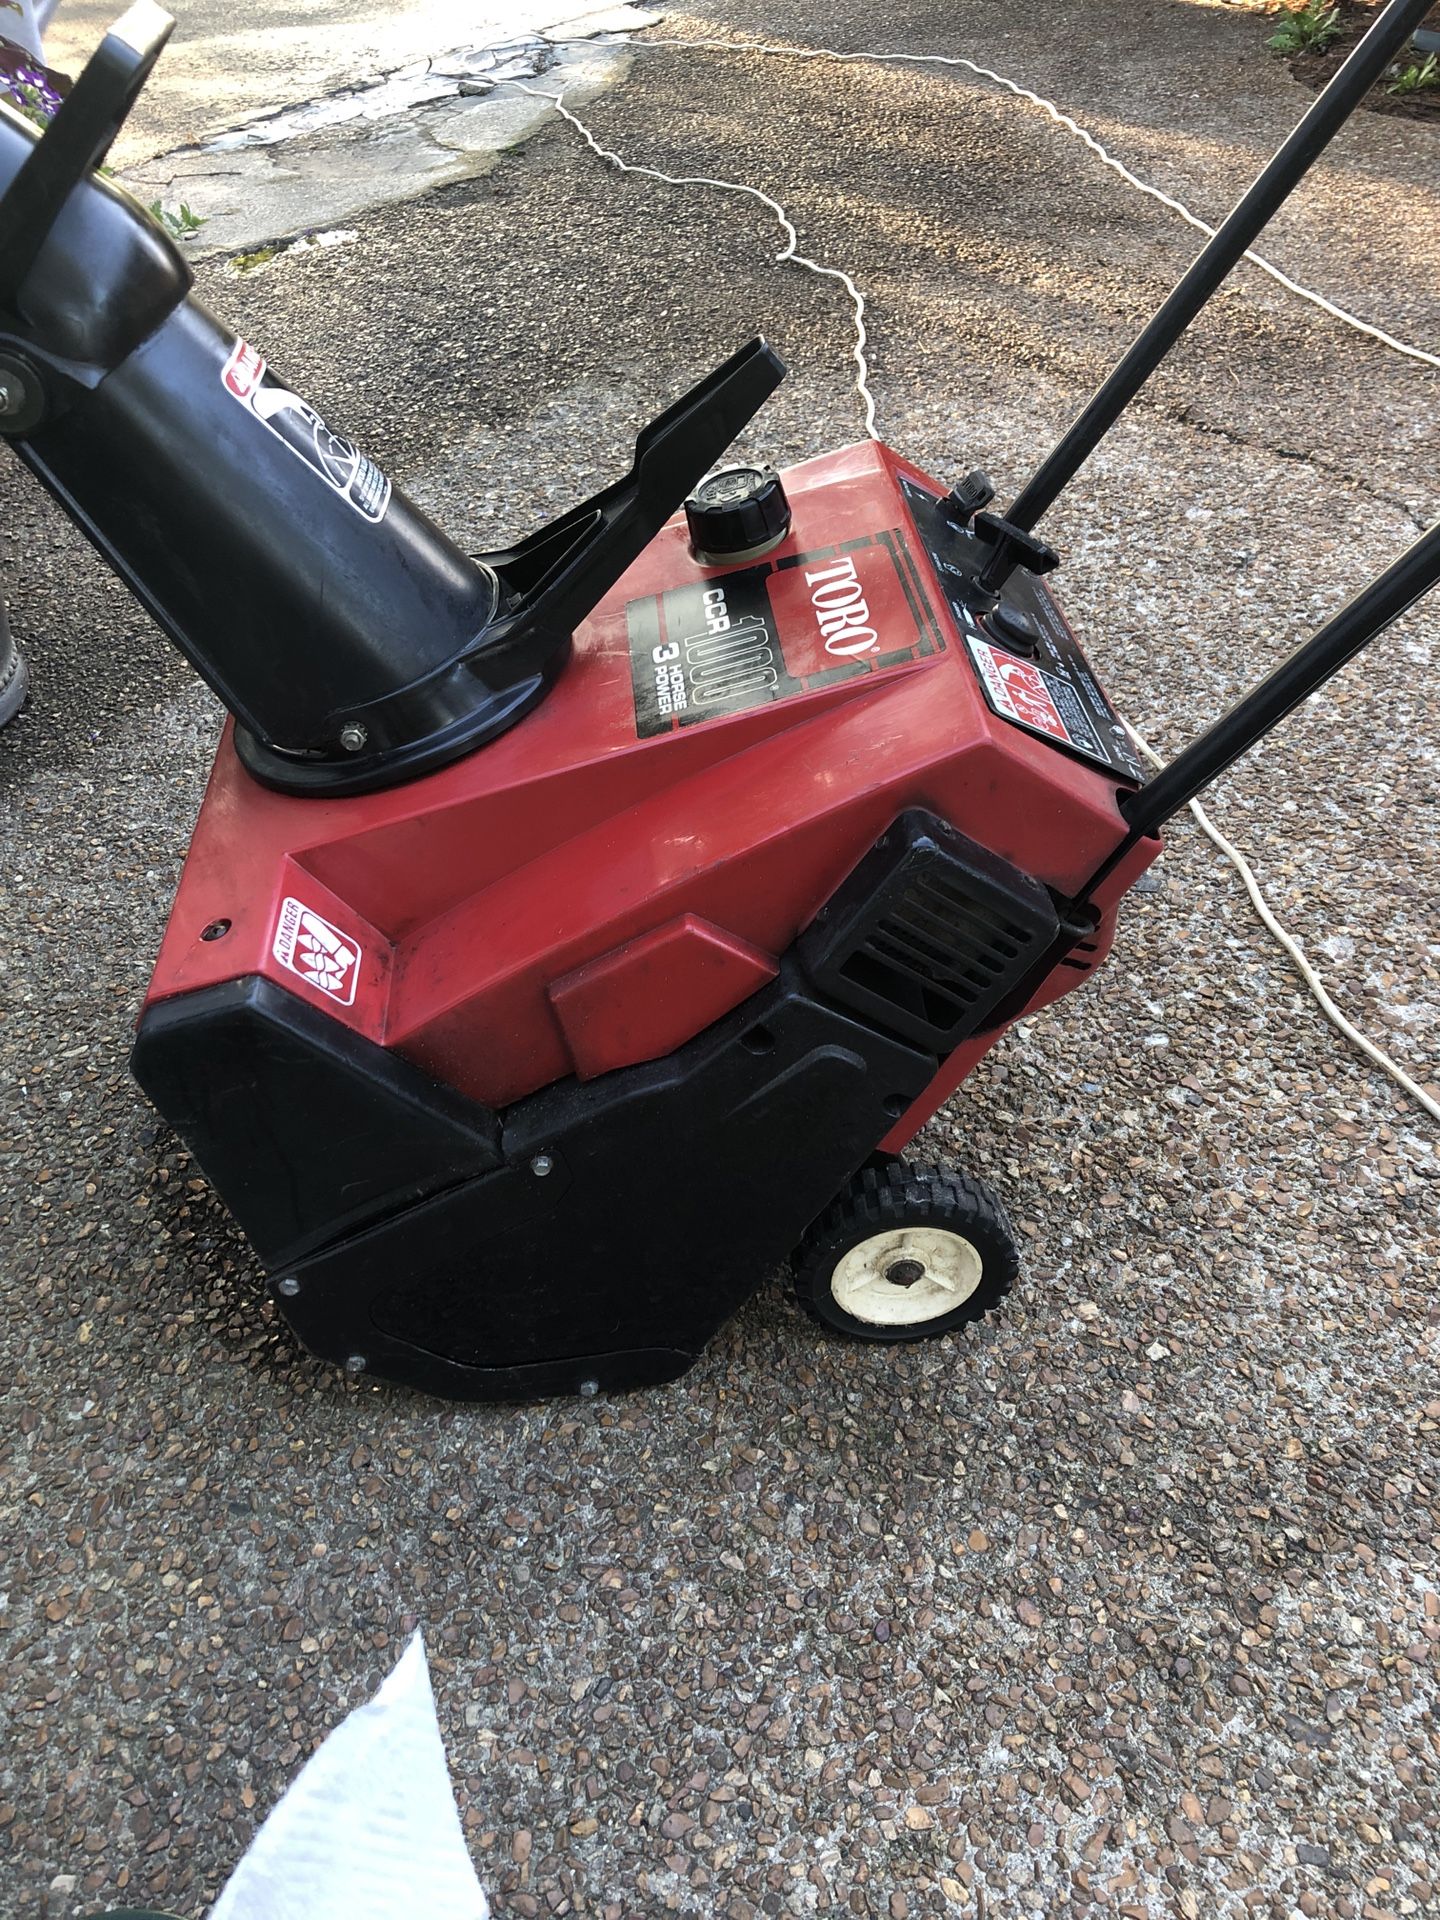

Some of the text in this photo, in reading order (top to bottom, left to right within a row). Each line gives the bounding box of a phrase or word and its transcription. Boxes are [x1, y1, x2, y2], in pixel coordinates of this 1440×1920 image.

[684, 587, 778, 705] CCR 1000
[652, 641, 688, 712] 3 HORSE
[654, 665, 673, 715] POWER
[976, 648, 1006, 697] DANGER
[279, 900, 299, 950] DANGER
